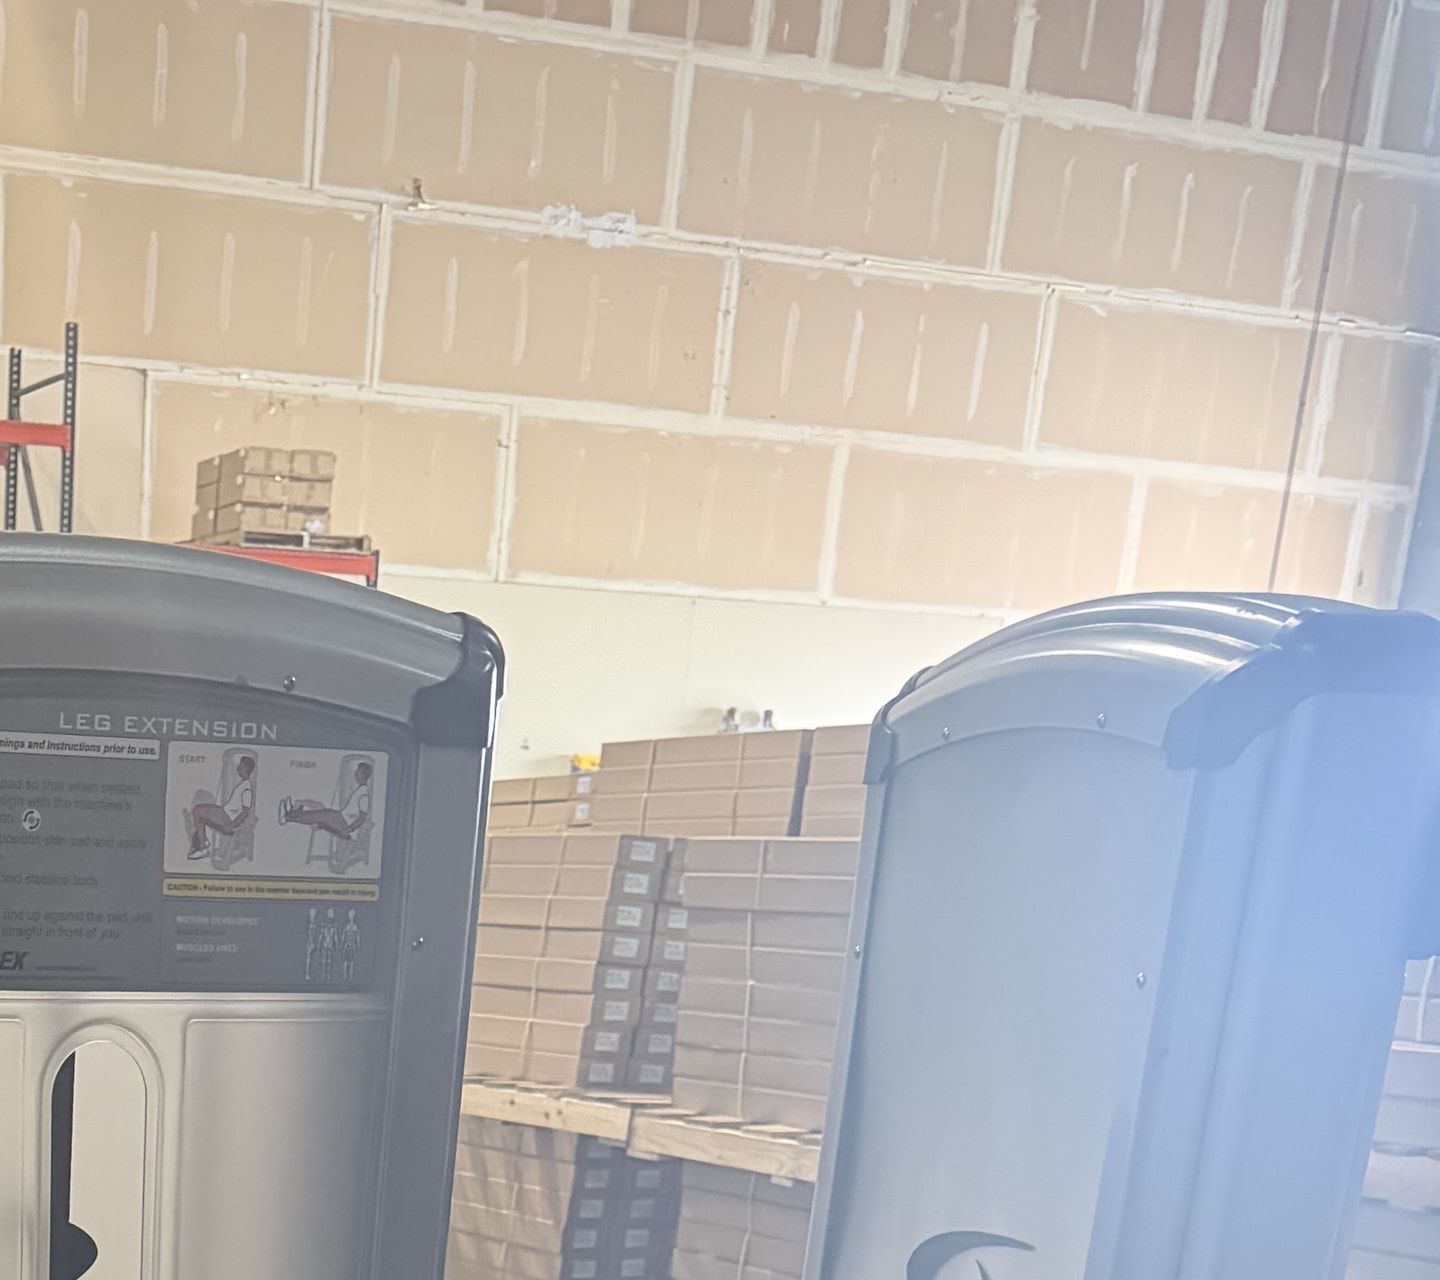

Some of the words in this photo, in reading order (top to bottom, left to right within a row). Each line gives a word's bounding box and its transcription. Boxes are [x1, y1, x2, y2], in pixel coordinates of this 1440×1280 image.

[59, 712, 112, 732] LEG
[123, 715, 280, 741] EXTENSION
[27, 739, 46, 749] and
[102, 742, 125, 755] prior
[127, 745, 137, 754] to
[138, 746, 157, 756] use.
